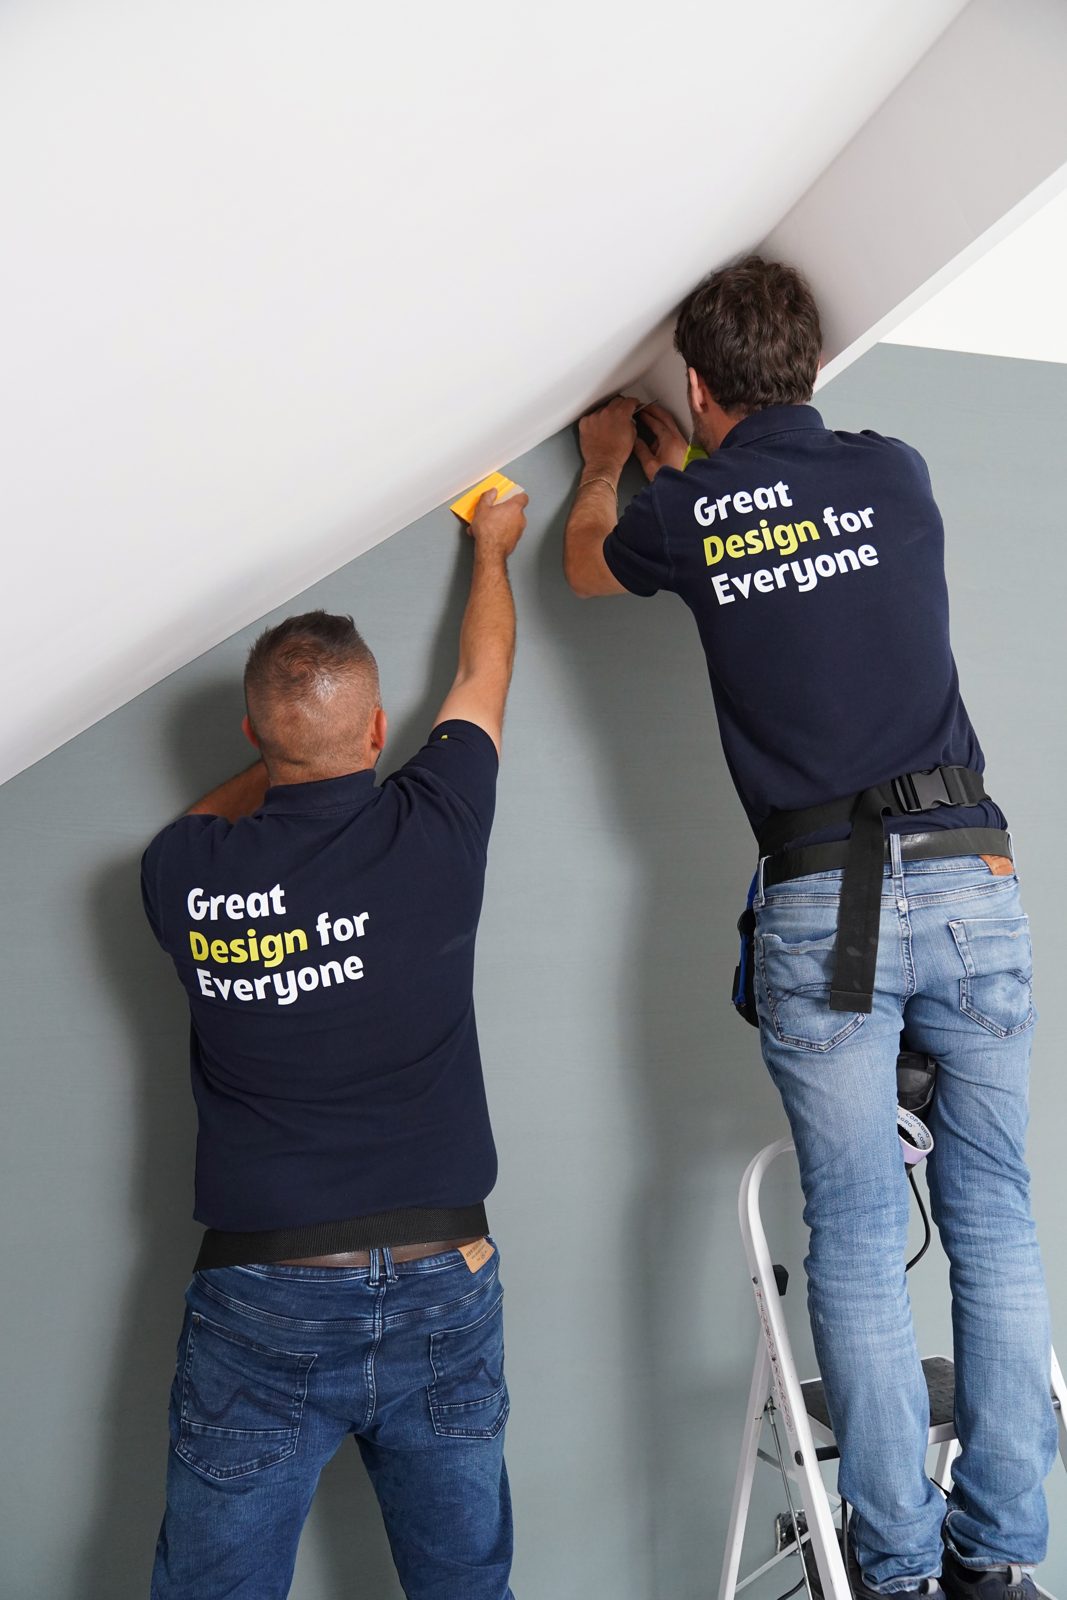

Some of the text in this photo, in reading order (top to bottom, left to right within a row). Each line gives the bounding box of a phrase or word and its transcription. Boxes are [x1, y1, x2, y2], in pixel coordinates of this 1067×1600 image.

[693, 480, 793, 527] Great
[702, 506, 875, 567] Design for
[710, 544, 880, 606] Everyone
[187, 883, 287, 921] Great
[189, 911, 370, 968] Design for
[196, 955, 365, 1006] Everyone
